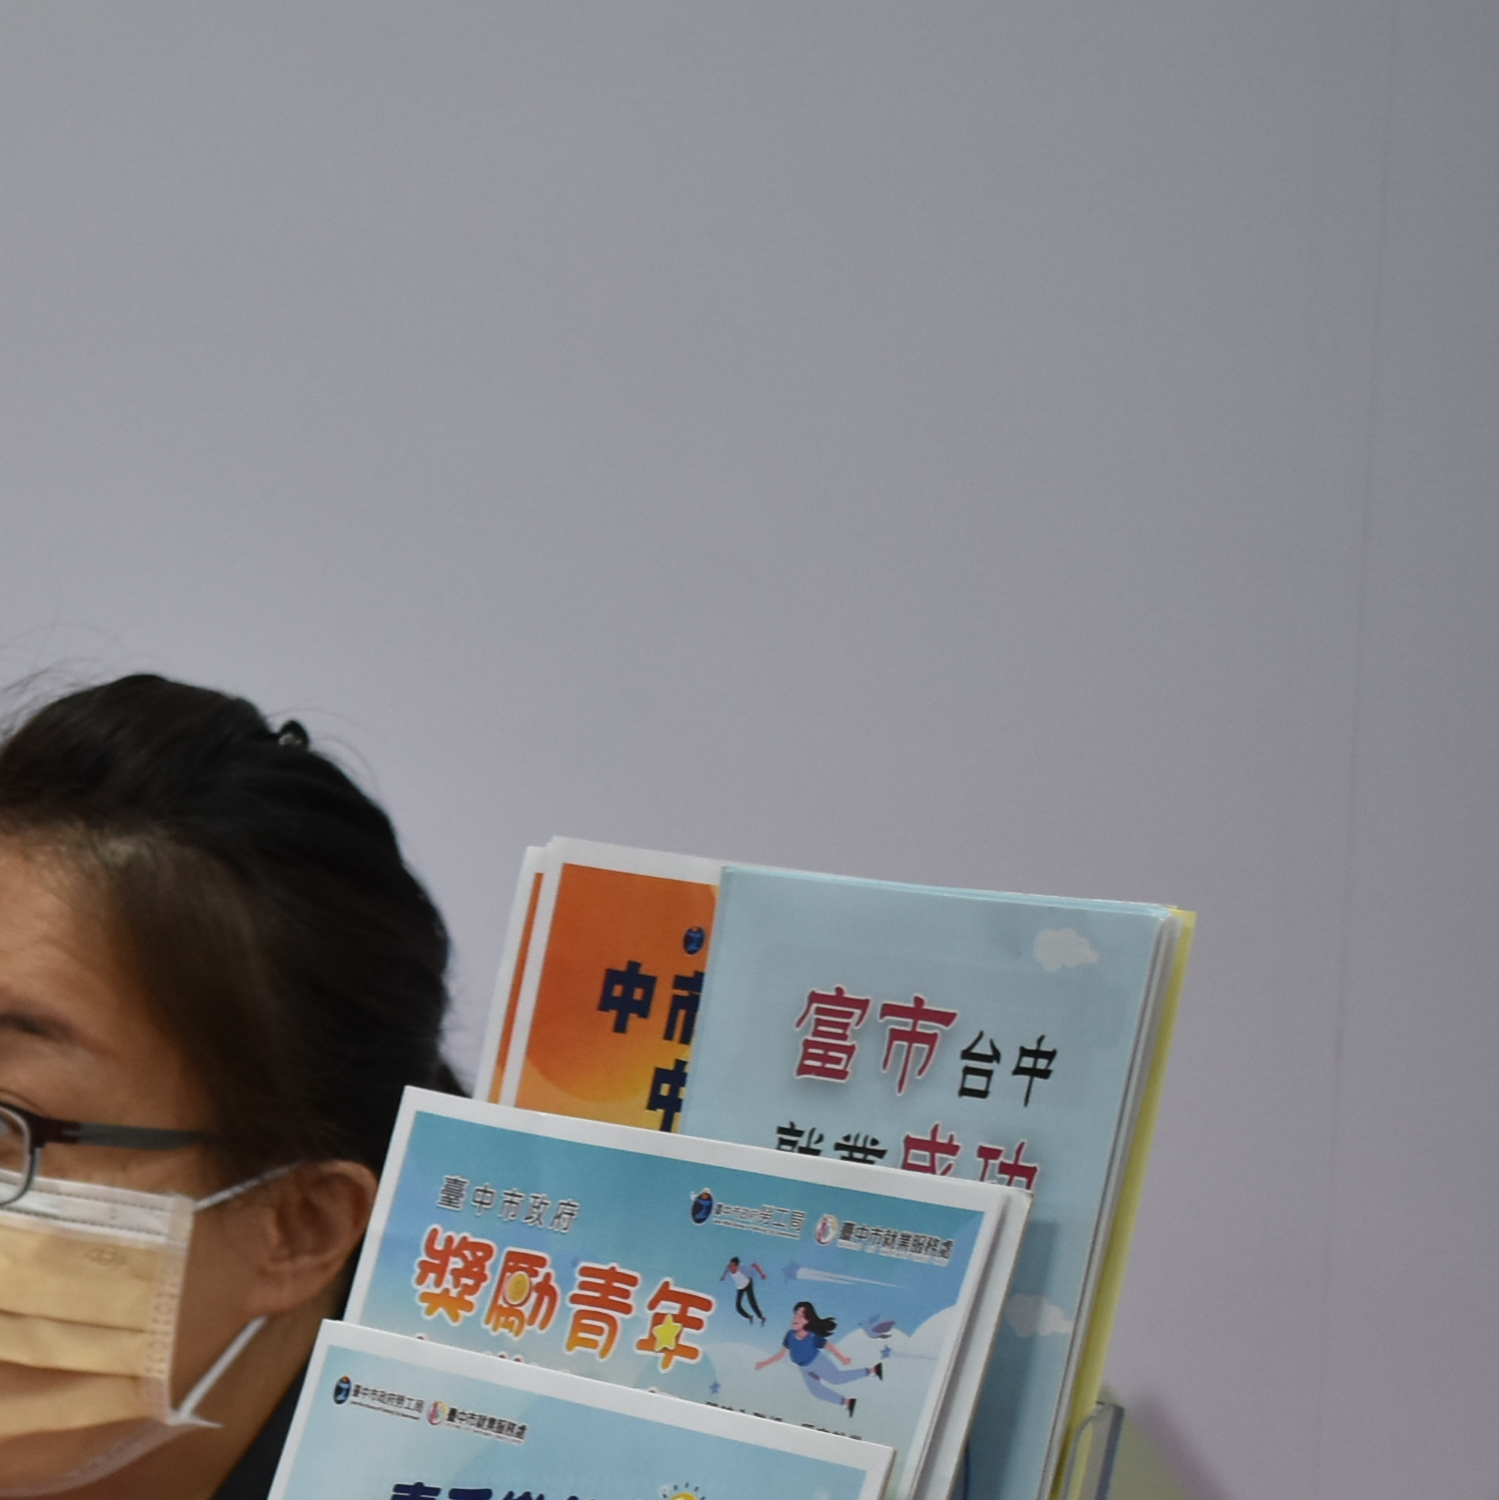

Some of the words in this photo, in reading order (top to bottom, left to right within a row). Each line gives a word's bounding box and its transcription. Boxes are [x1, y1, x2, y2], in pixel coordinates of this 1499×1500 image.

[793, 985, 1059, 1109] 富市台中
[436, 1173, 580, 1236] 臺中市政府
[840, 1220, 955, 1260] 臺中市就業服務處
[414, 1222, 717, 1373] 獎勵青年
